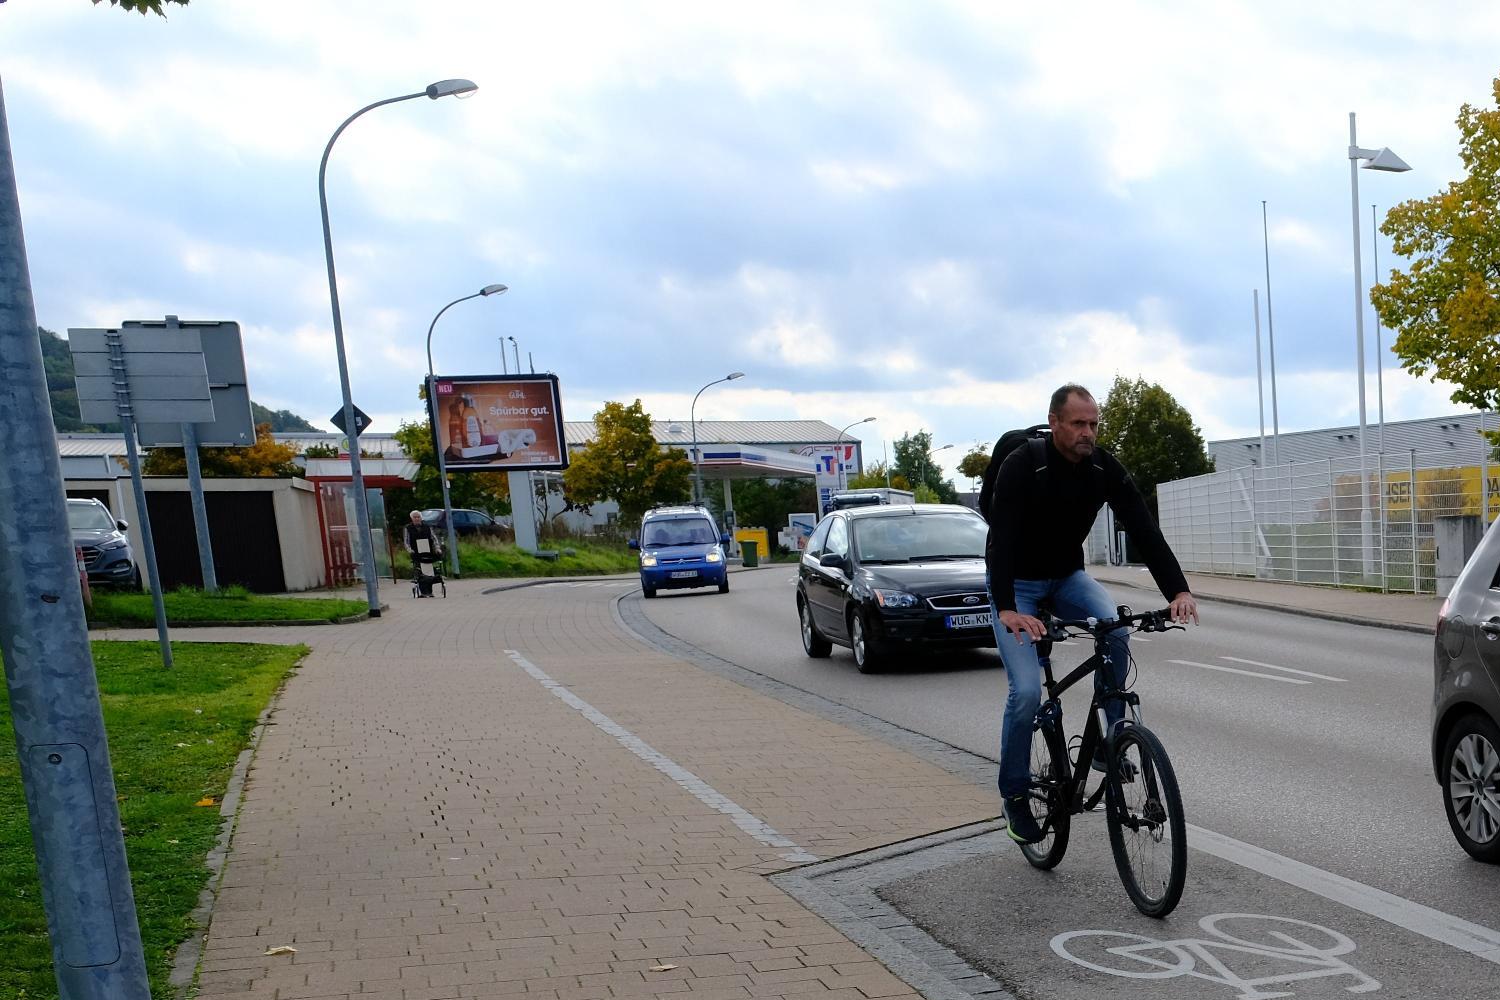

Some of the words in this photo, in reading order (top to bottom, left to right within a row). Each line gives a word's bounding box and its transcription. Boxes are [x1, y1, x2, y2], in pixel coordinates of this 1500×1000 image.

[438, 384, 452, 393] NEU
[489, 406, 529, 416] Spürbar
[530, 406, 550, 417] gut.
[951, 616, 970, 626] WUG
